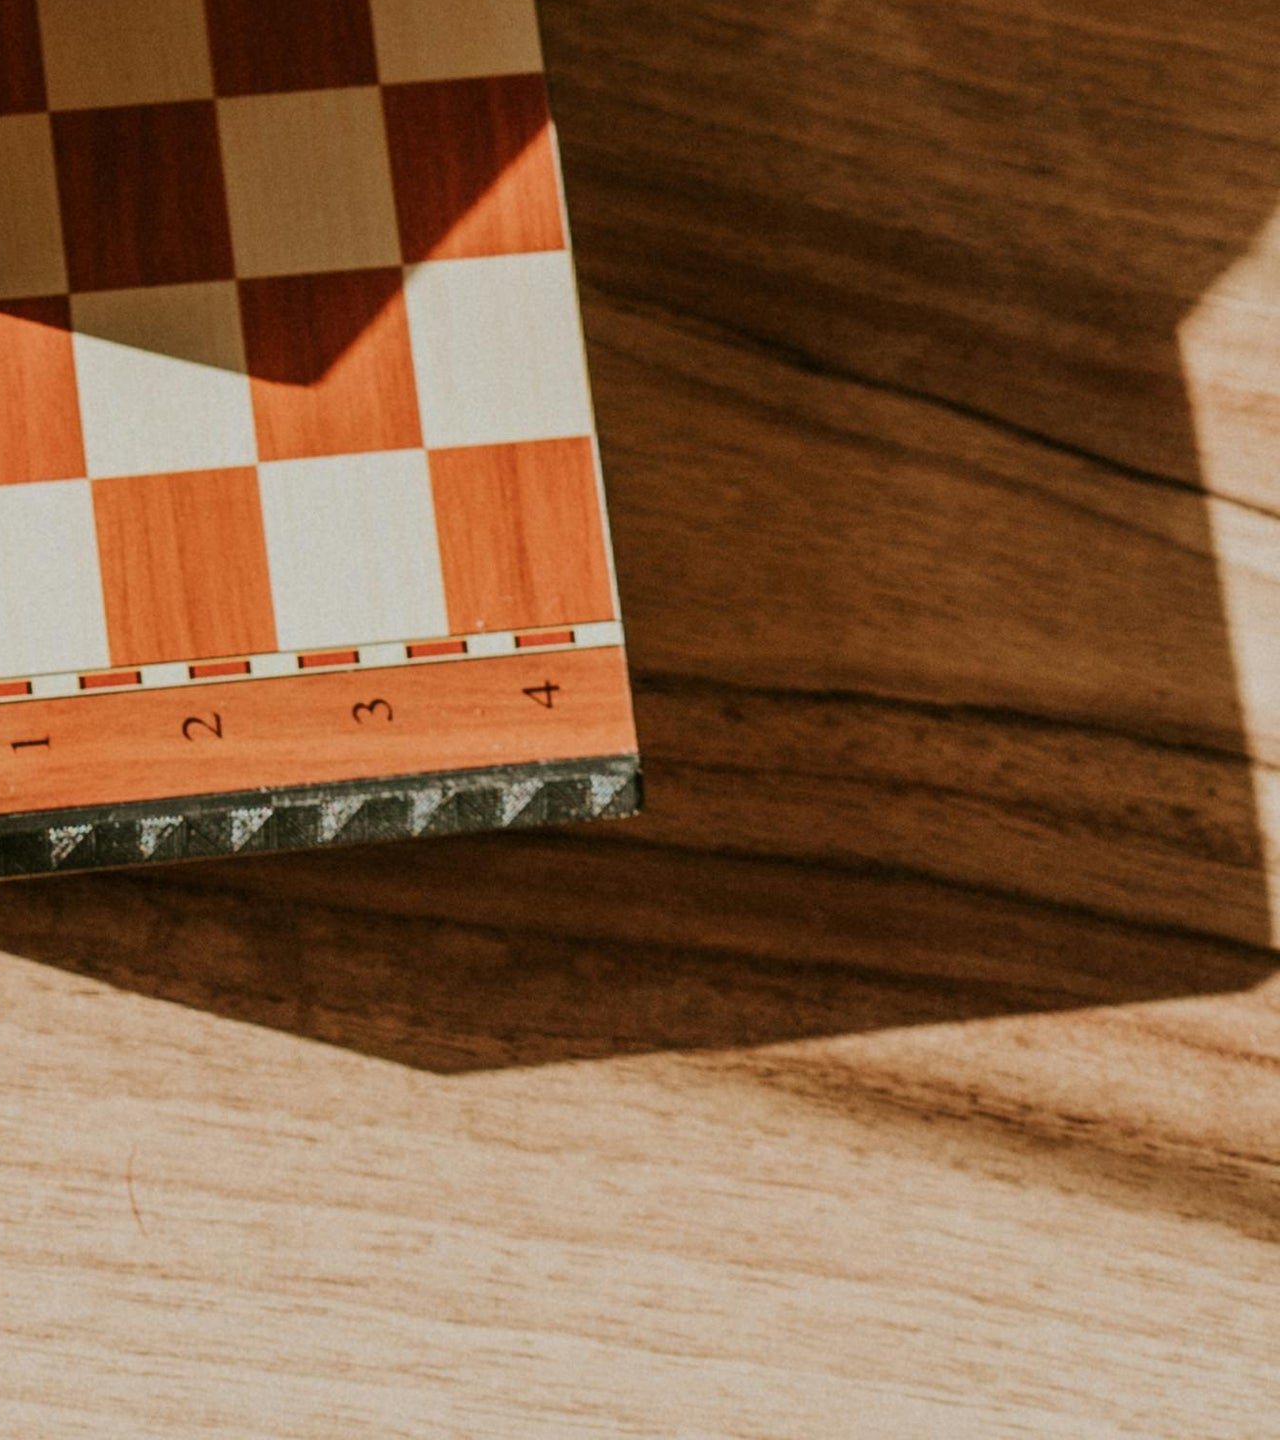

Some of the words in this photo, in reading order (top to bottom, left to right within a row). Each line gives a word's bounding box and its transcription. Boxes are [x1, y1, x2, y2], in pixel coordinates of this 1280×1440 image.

[10, 735, 51, 753] 1
[180, 710, 224, 742] 2
[352, 694, 395, 725] 3
[520, 679, 561, 710] 4
